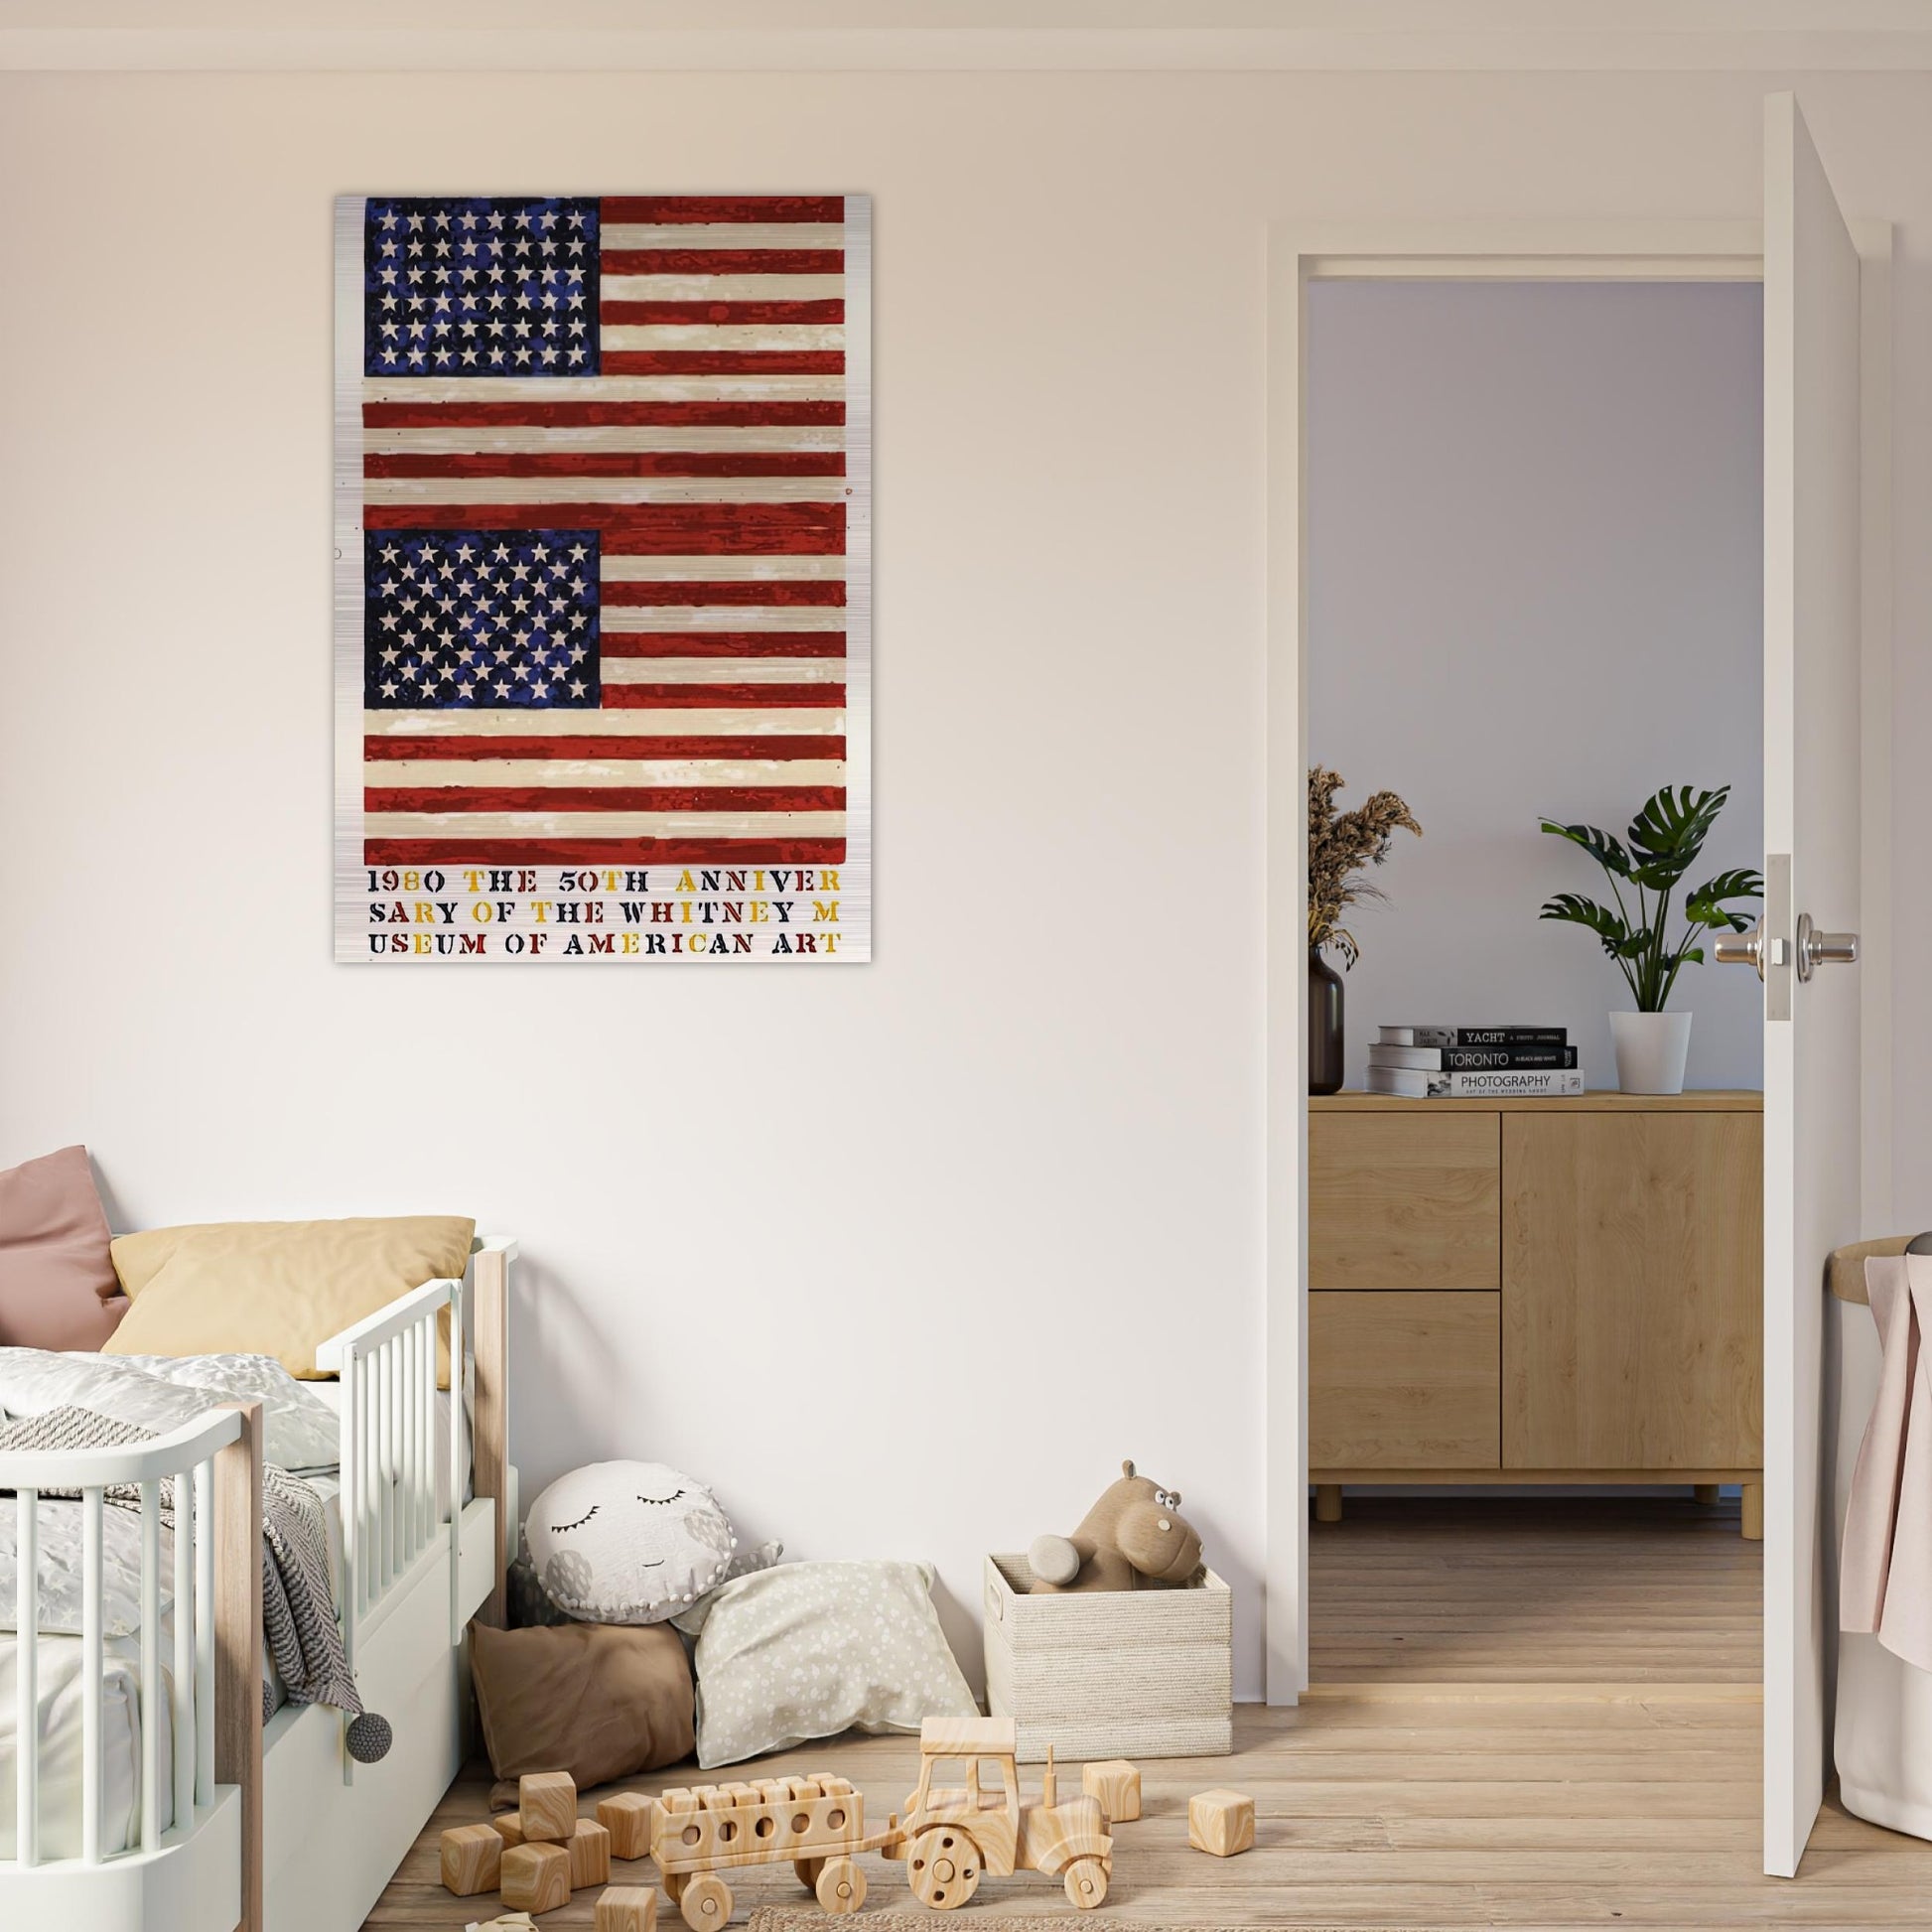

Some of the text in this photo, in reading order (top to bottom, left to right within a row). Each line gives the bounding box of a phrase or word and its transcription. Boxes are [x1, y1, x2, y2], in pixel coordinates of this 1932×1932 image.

[368, 870, 841, 894] 1980 THE 50TH ANNIVER
[369, 901, 841, 925] SARY OF THE WHITNEY M
[368, 933, 842, 955] USEUM OF AMERICAN ART
[1465, 1033, 1506, 1043] YACHT
[1448, 1052, 1509, 1066] TORONTO
[1461, 1075, 1551, 1087] PHOTOGRAPHY
